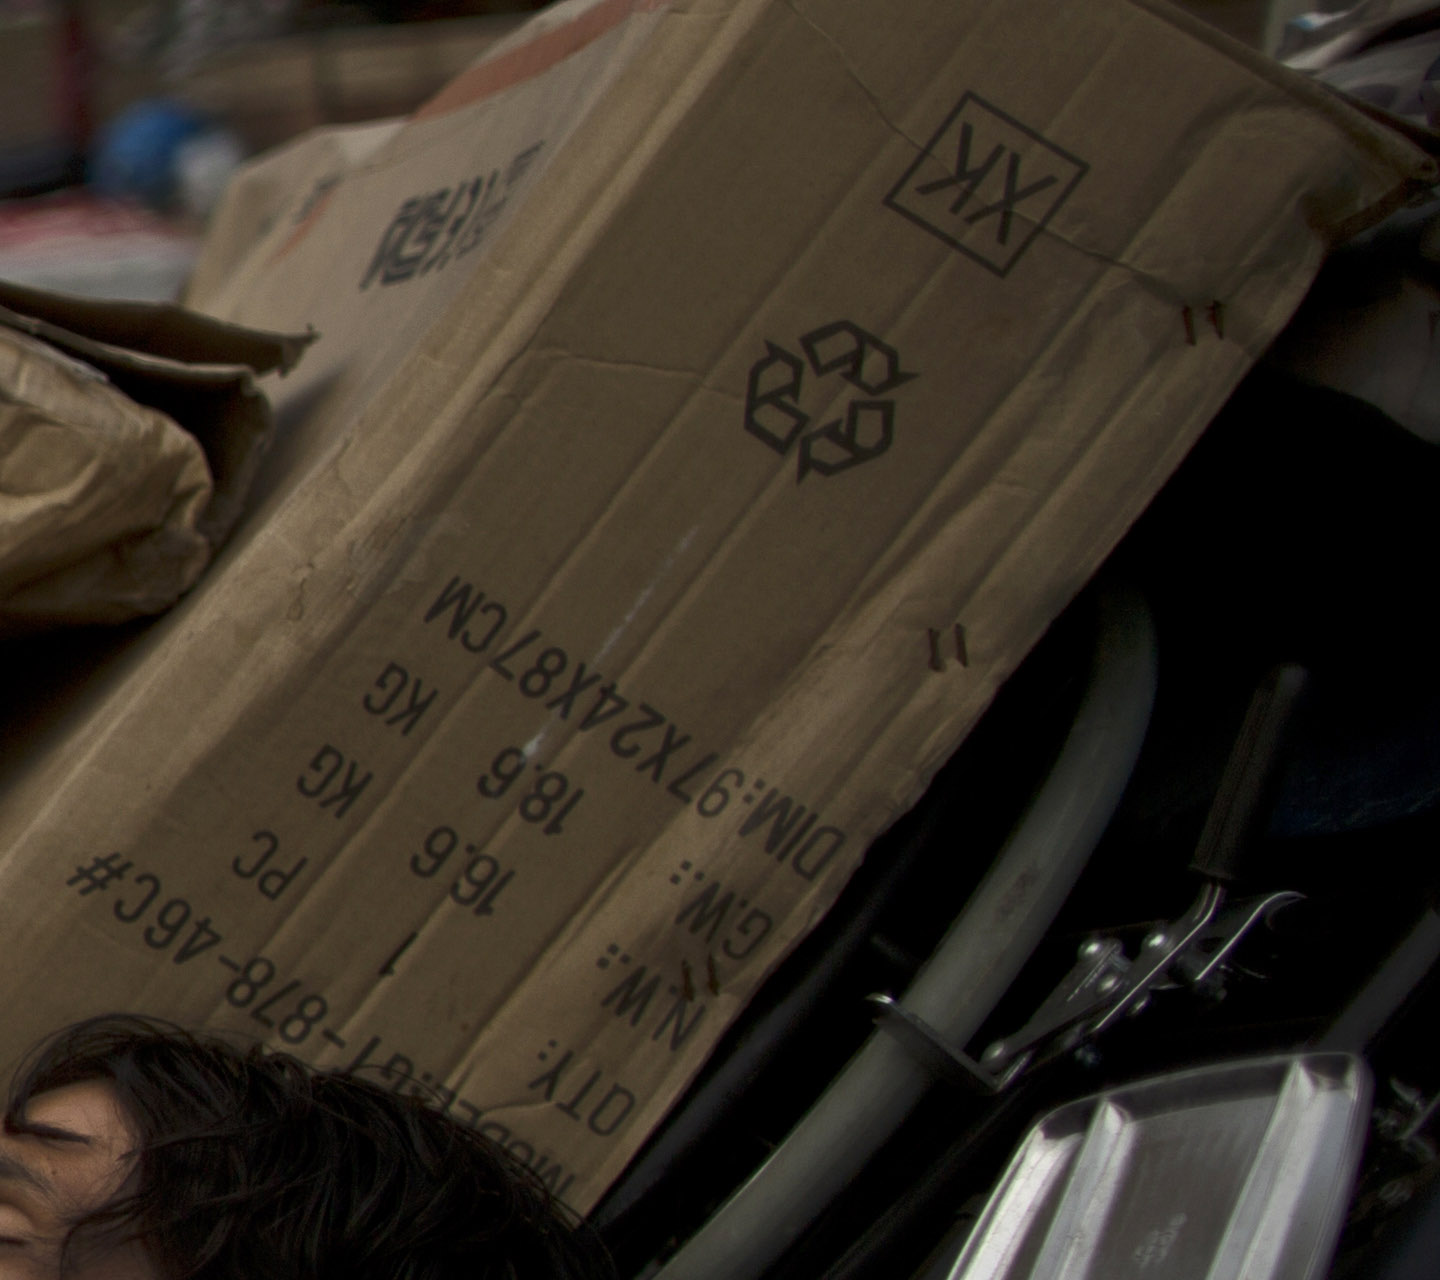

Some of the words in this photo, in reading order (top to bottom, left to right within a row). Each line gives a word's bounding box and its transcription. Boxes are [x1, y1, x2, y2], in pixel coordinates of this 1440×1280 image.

[918, 125, 1056, 245] XK
[363, 661, 438, 736] KG
[297, 744, 372, 818] KG
[478, 746, 586, 836] 18.6
[232, 830, 308, 901] PC
[410, 826, 515, 917] 16.6
[379, 931, 418, 978] 1
[528, 1040, 636, 1137] QTY:
